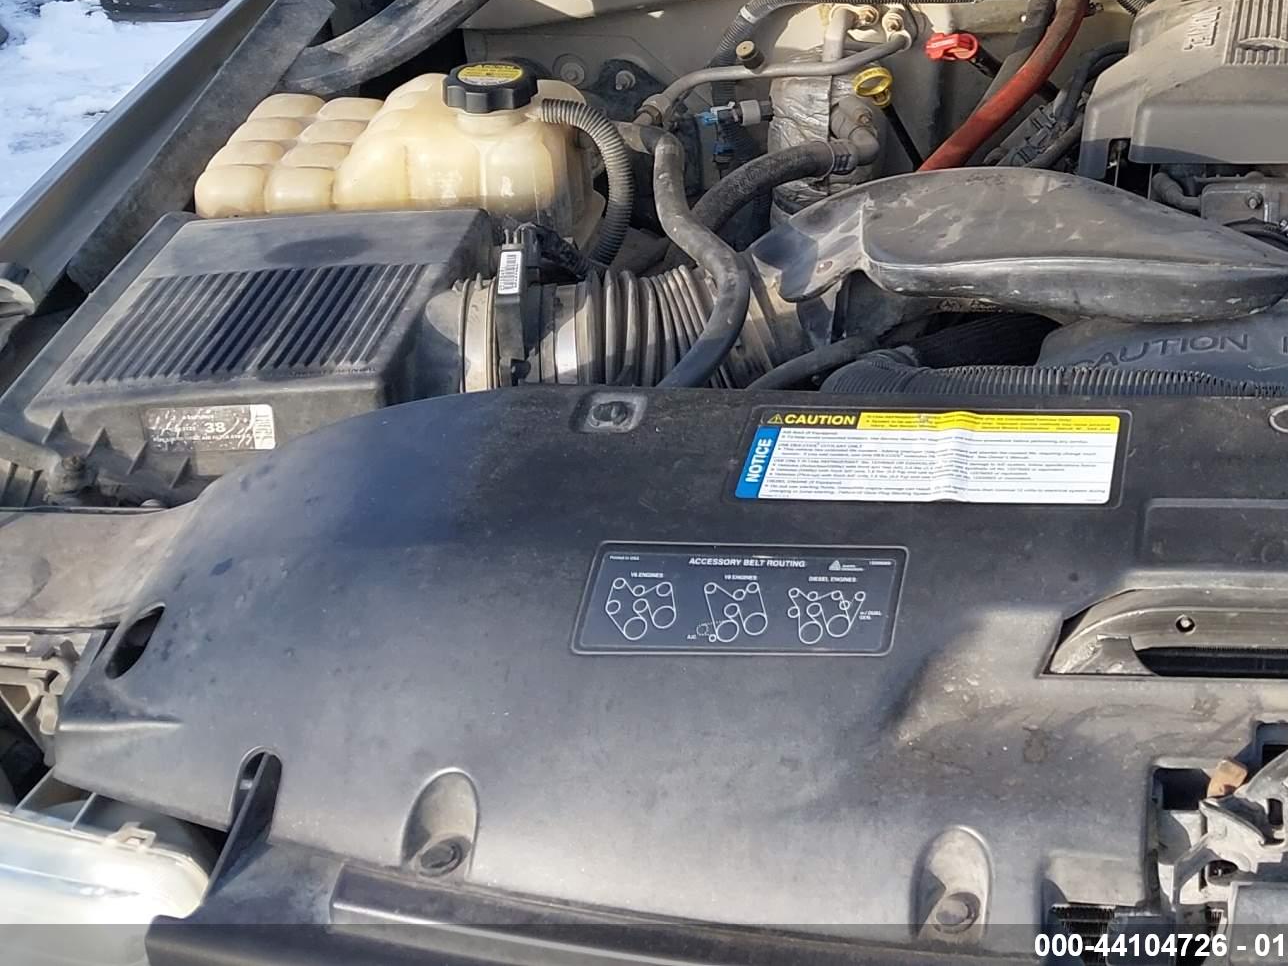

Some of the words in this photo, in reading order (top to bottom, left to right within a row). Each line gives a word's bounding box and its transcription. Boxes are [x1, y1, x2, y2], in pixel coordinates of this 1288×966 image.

[784, 413, 856, 426] CAUTION
[204, 421, 226, 433] 38
[745, 438, 775, 484] NOTICE
[688, 557, 742, 566] ACCESSORY
[743, 559, 765, 567] BELT
[767, 560, 806, 568] ROUTING
